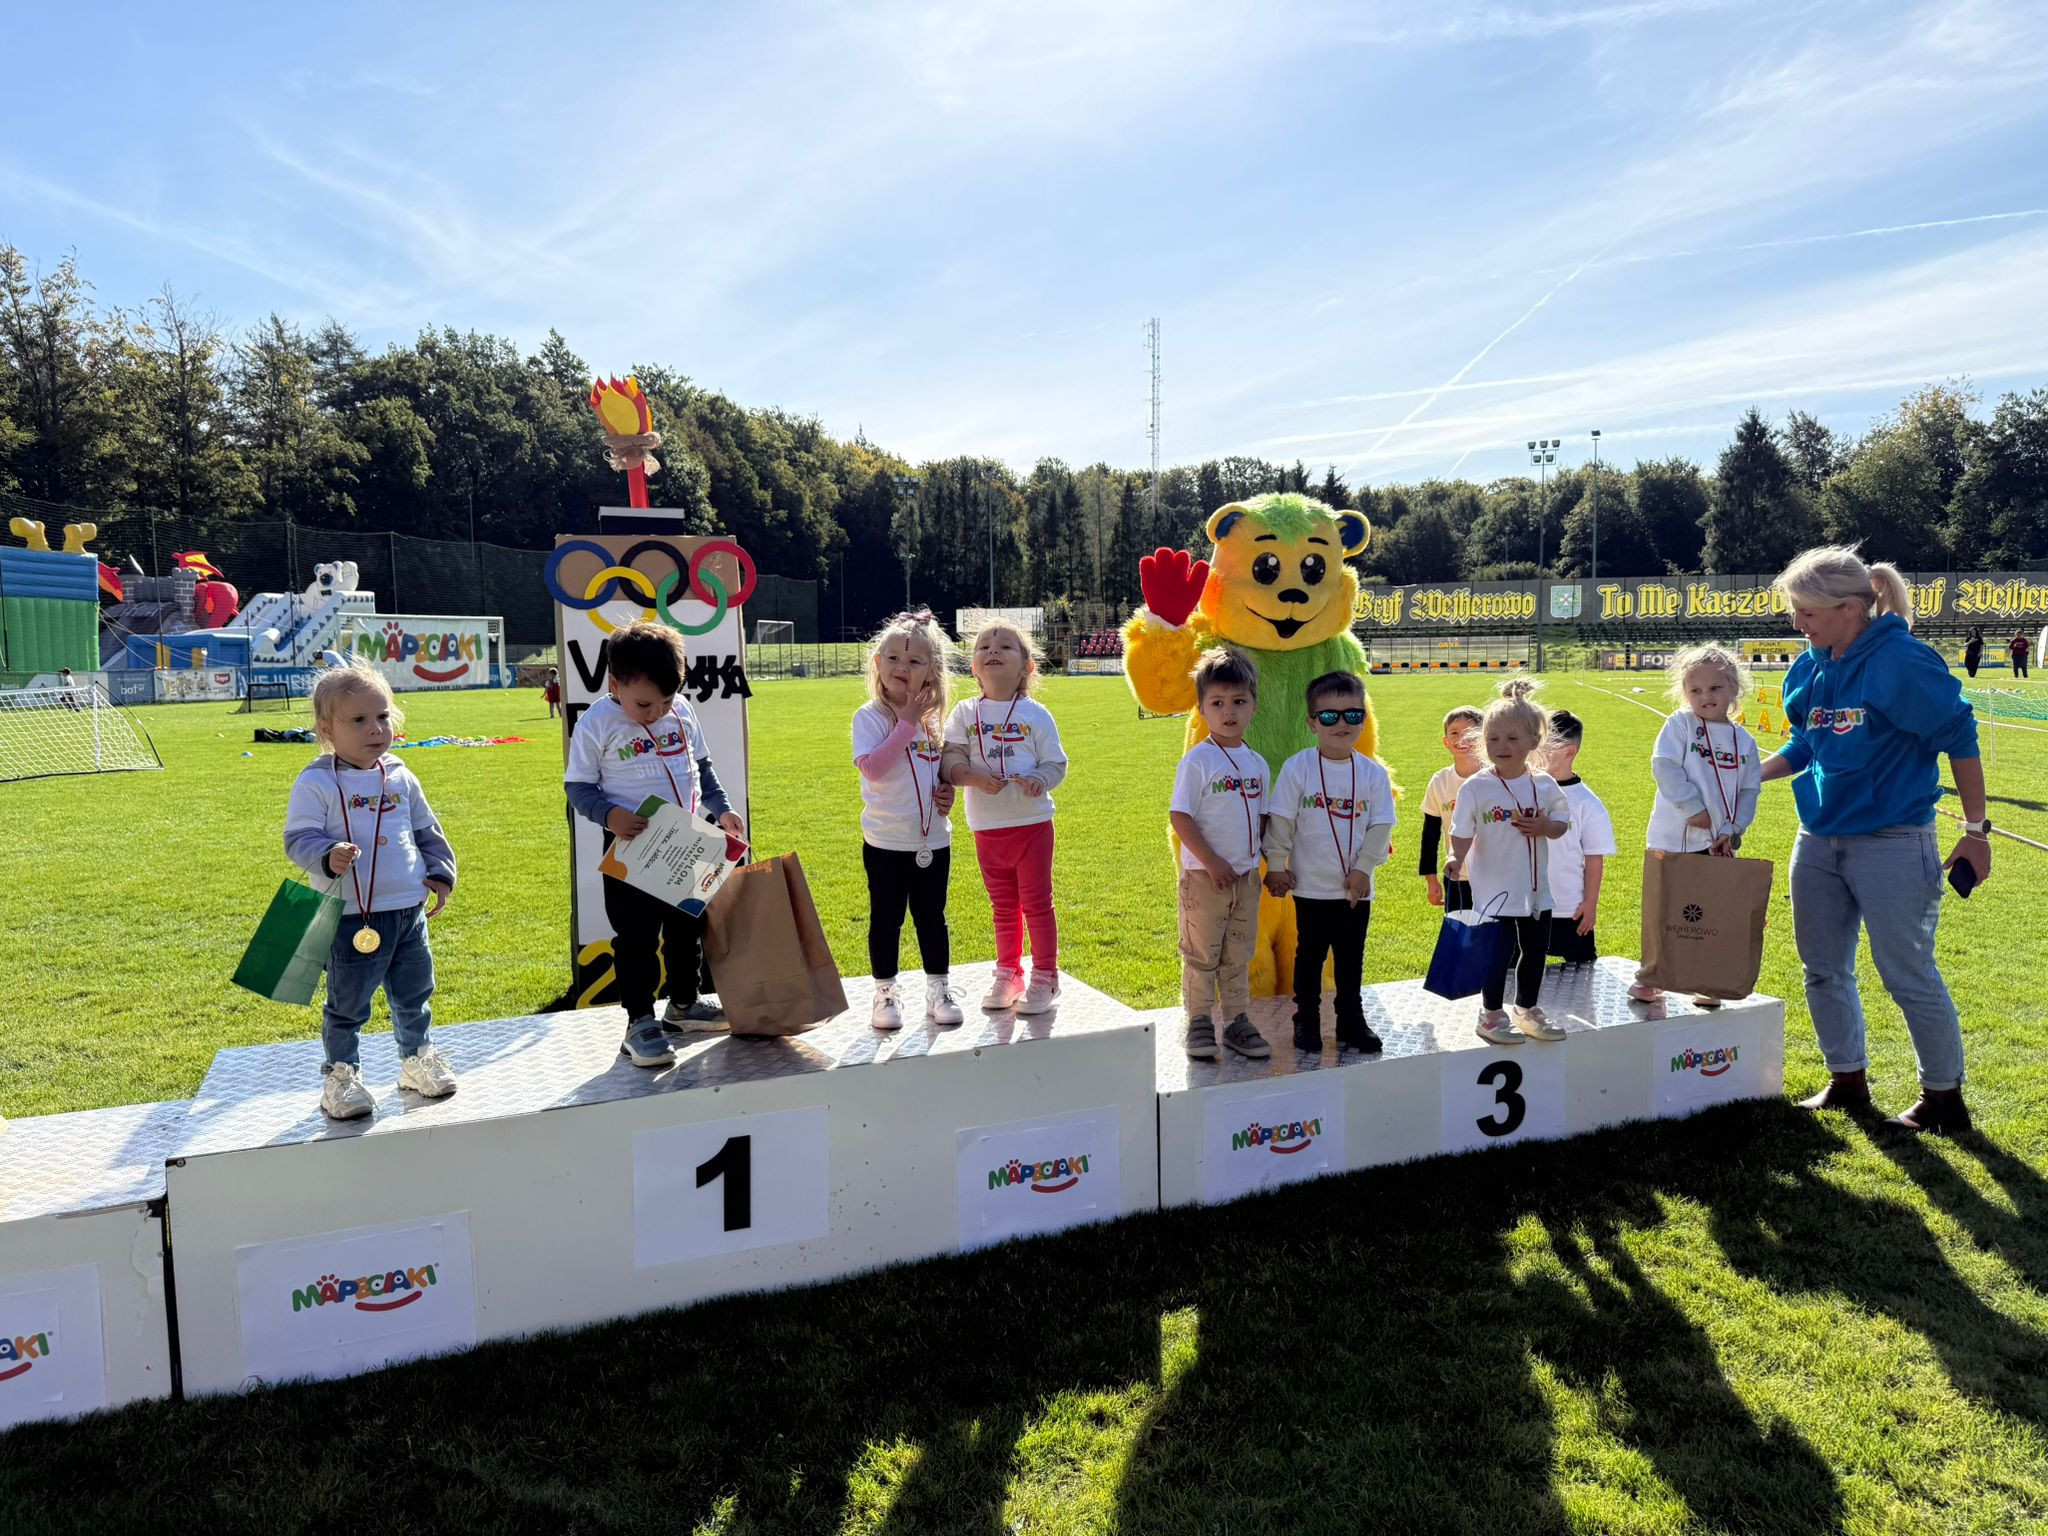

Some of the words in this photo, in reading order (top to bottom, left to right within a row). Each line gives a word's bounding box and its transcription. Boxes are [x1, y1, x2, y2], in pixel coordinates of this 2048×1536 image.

[1410, 587, 1536, 624] Wejherowo
[1597, 584, 1633, 619] To
[1637, 583, 1682, 618] Më
[1685, 583, 1788, 617] Kaszëb
[1908, 577, 1946, 617] ryf
[357, 621, 483, 663] MAPECIAKI
[674, 846, 706, 886] DYPLOM
[682, 836, 703, 861] MISTRZA
[665, 861, 686, 885] IGRZYSK
[1665, 924, 1719, 937] WEJHEROWO
[1669, 1046, 1739, 1073] MAPECIAKI
[1475, 1060, 1527, 1137] 3
[1232, 1119, 1321, 1152] MAPECIAKI
[695, 1134, 751, 1232] 1
[988, 1153, 1090, 1191] MAPECIAKI
[291, 1265, 438, 1312] MAPECIAKI
